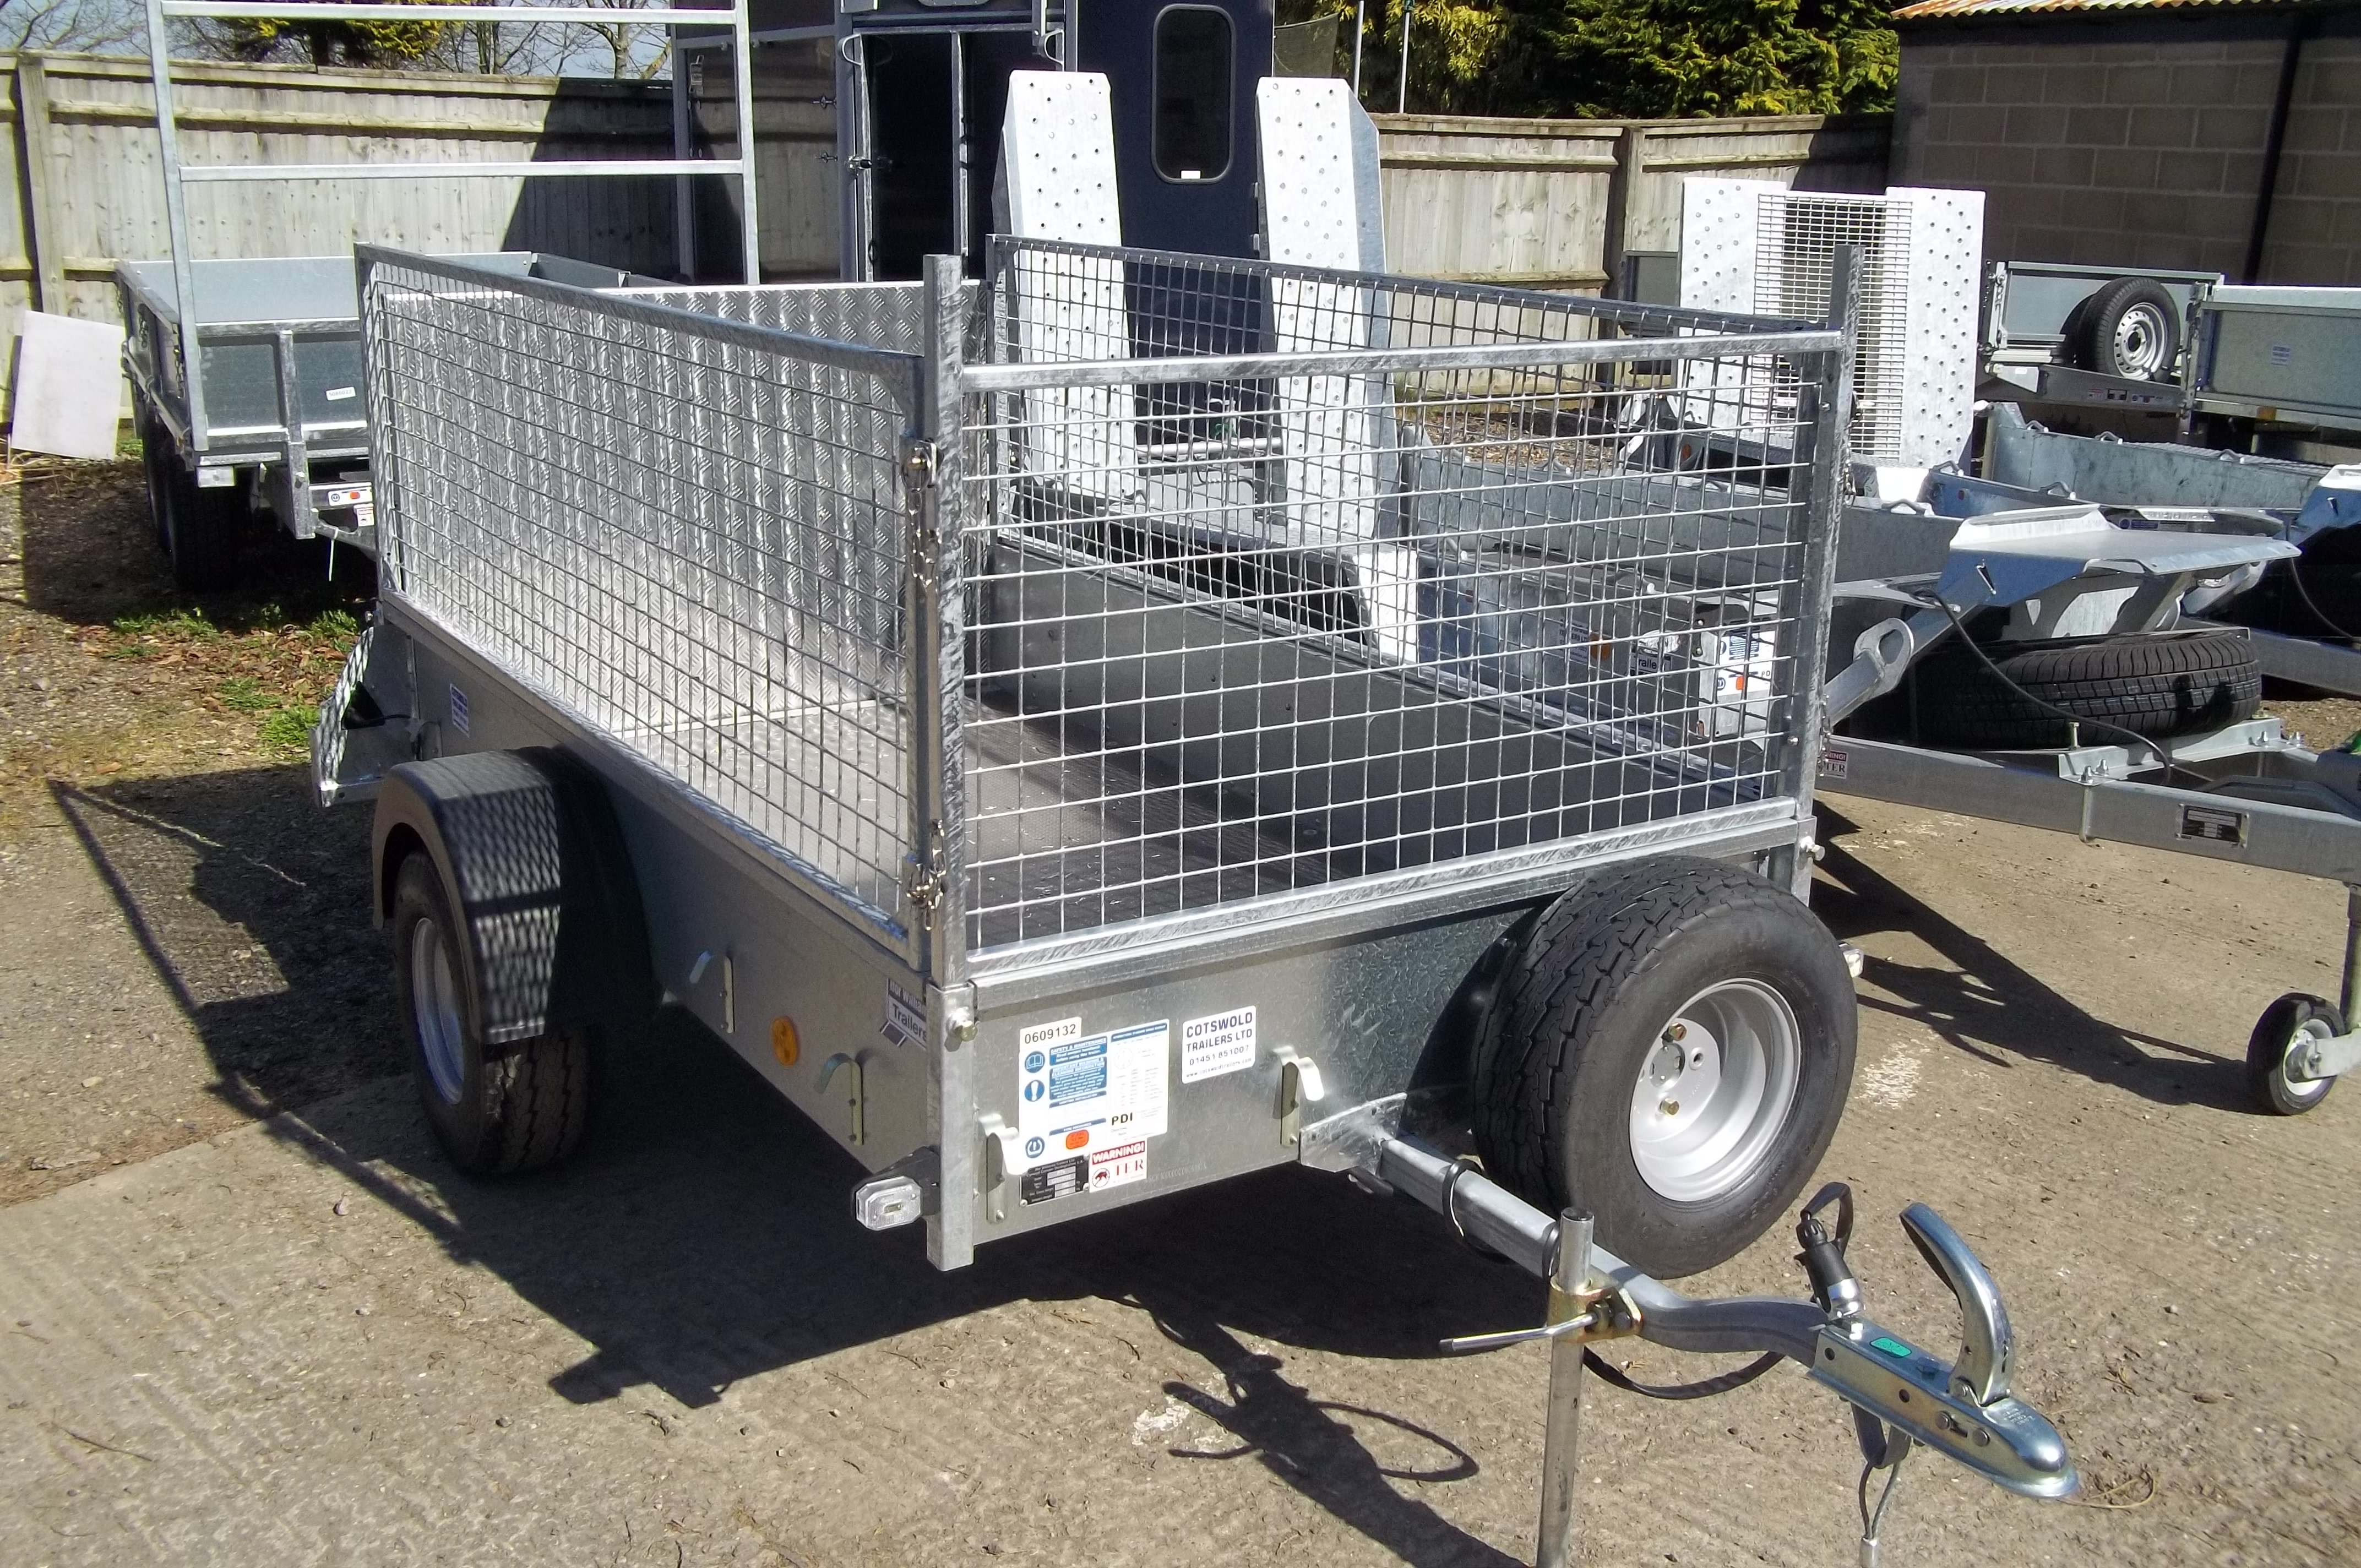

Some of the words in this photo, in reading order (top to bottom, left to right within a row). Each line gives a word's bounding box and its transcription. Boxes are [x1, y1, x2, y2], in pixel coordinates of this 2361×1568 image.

[1025, 1023, 1076, 1044] 0609132
[1187, 1012, 1253, 1038] COTSWOLD
[1187, 1033, 1232, 1053] TRAILERS
[1236, 1028, 1252, 1041] LTD
[1189, 1053, 1215, 1065] 01451
[1218, 1045, 1249, 1058] 851007
[1112, 1112, 1133, 1125] PDI
[1092, 1141, 1144, 1163] WARNING!
